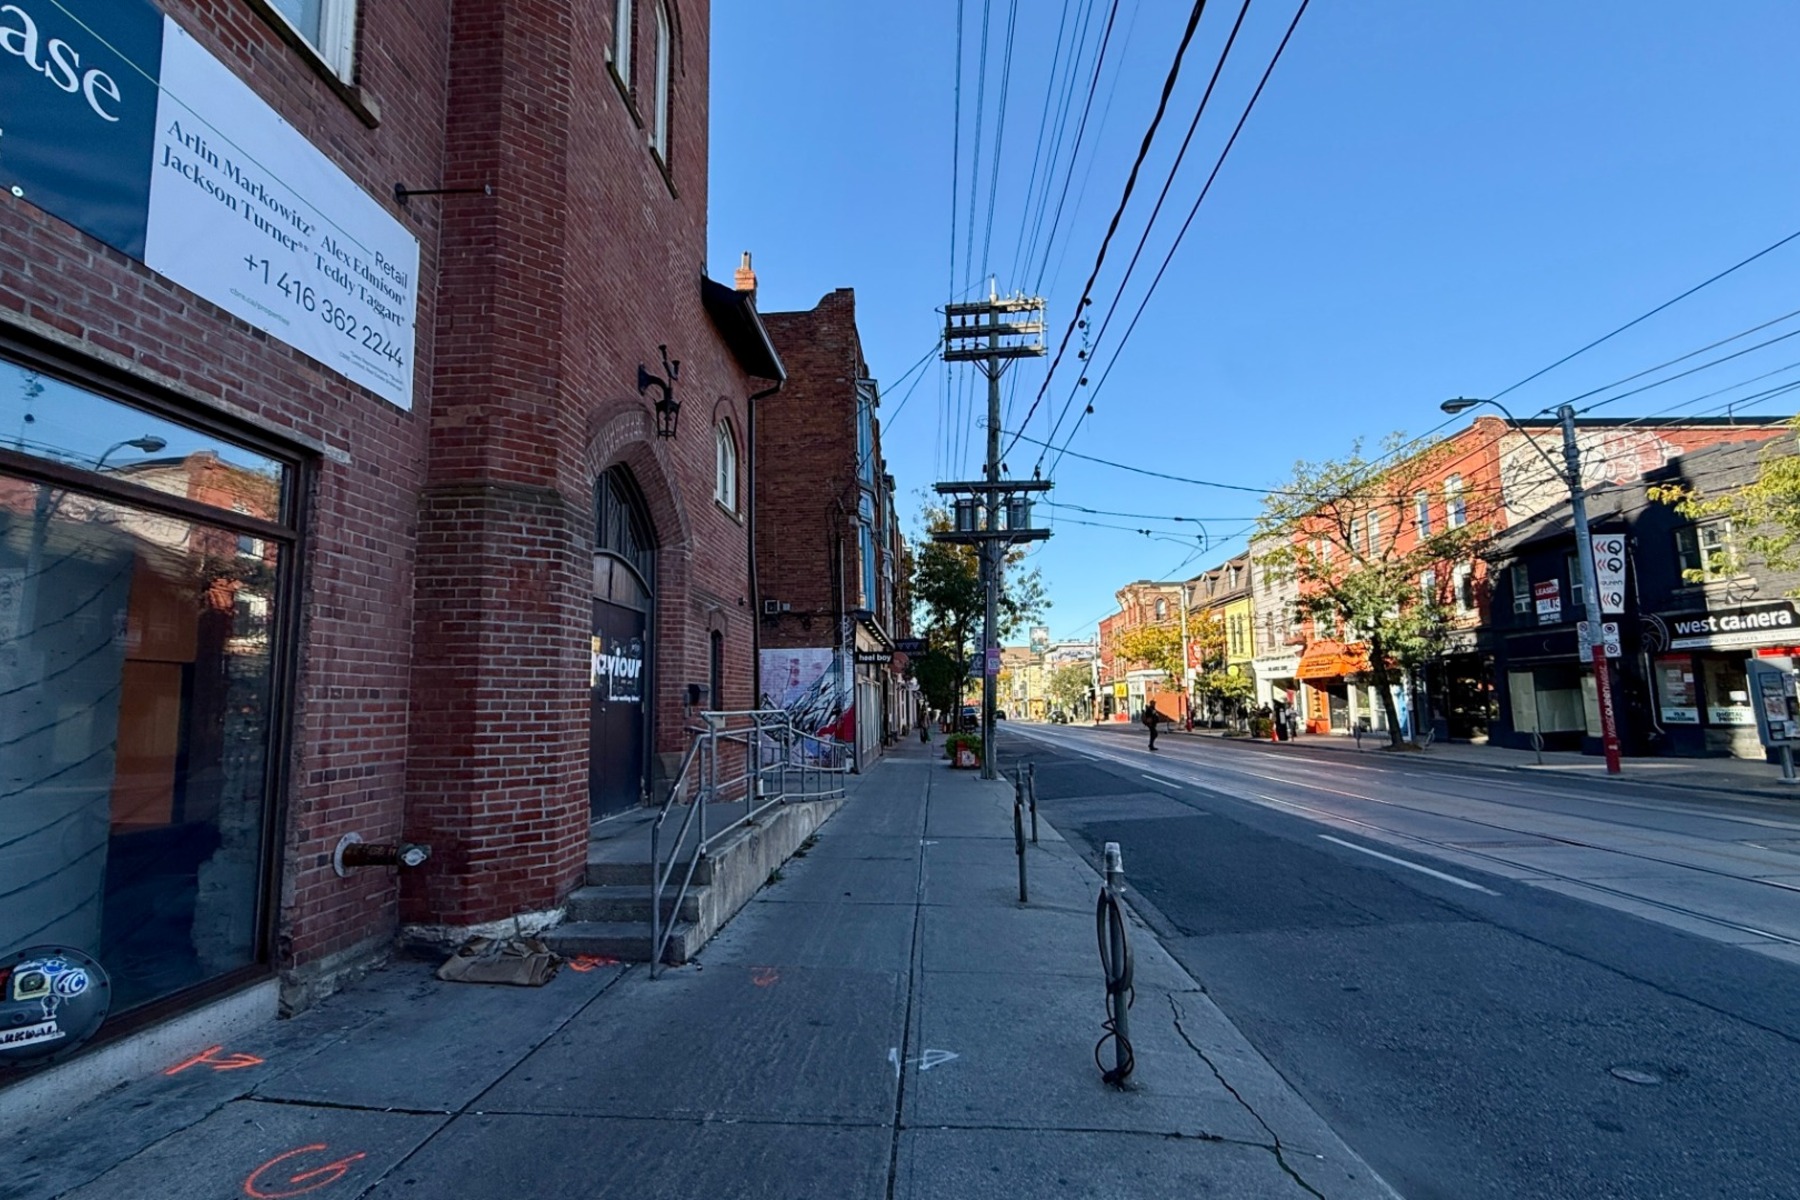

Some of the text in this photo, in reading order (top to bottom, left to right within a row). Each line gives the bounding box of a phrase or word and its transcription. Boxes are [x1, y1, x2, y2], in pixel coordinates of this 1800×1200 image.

[167, 120, 219, 170] Arlin
[320, 235, 351, 268] Alex
[160, 144, 237, 212] Jackson
[314, 252, 355, 296] Teddy
[374, 251, 408, 289] Retail
[243, 254, 403, 368] +1 416 362 2244
[1675, 610, 1792, 634] west camera
[591, 647, 642, 681] aviour
[876, 653, 892, 662] boy
